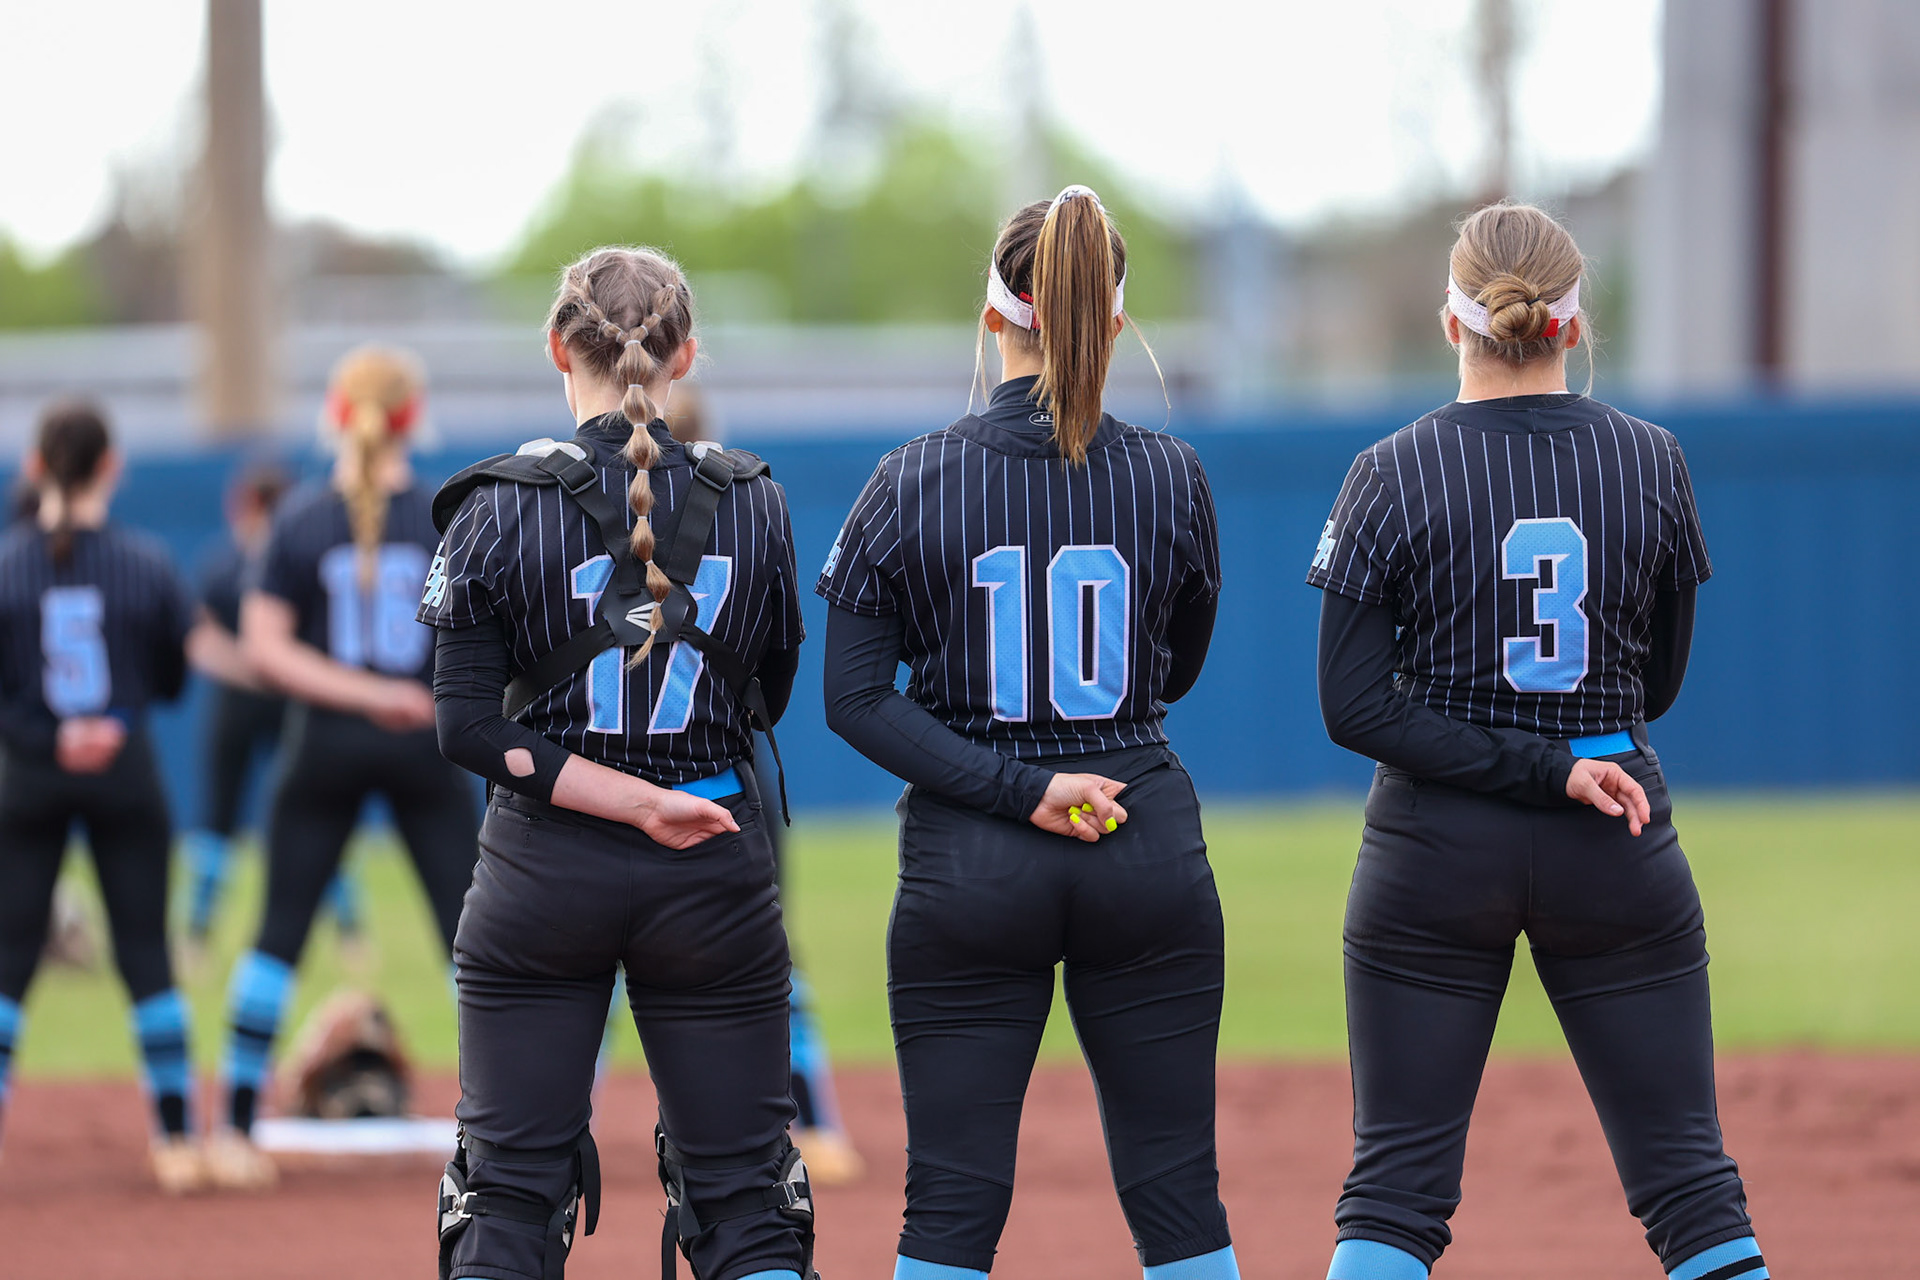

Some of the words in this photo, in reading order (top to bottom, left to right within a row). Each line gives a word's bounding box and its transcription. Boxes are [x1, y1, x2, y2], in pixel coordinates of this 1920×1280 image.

[39, 585, 112, 719] 5
[972, 544, 1131, 723] 10
[1501, 517, 1589, 693] 3
